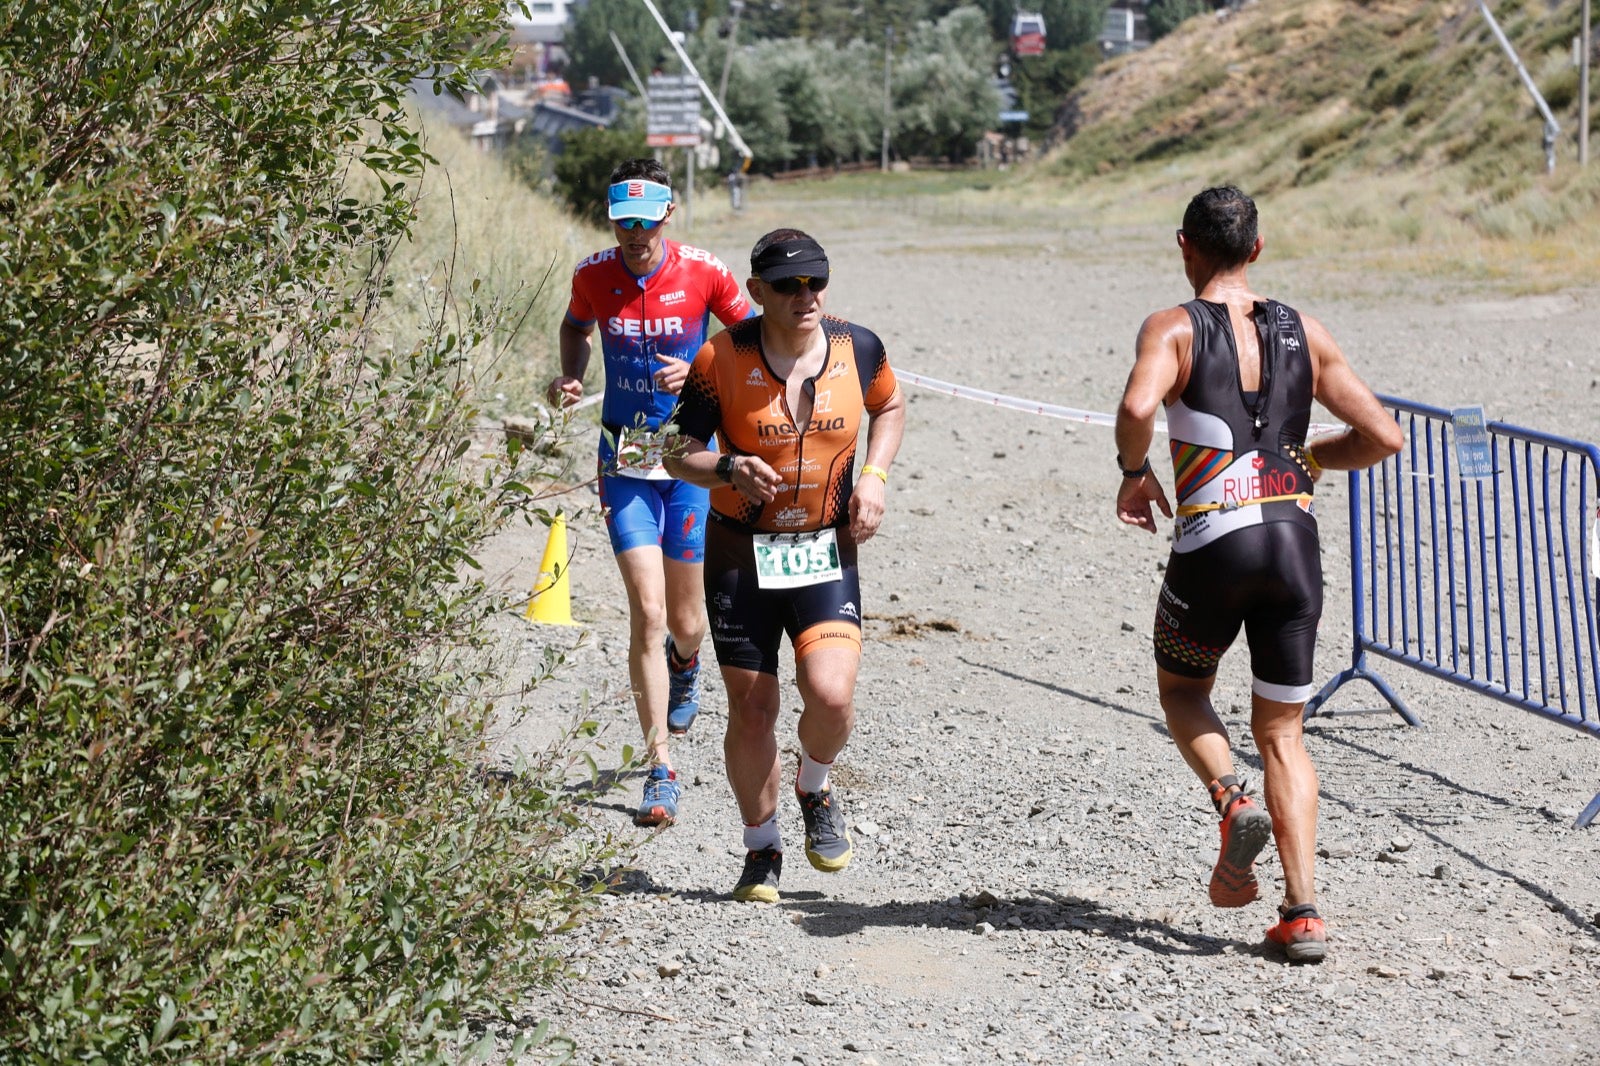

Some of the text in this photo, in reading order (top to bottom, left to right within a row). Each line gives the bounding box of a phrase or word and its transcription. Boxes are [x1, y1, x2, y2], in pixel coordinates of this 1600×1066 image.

[678, 245, 728, 277] SEUR
[659, 289, 686, 303] SEUR
[608, 316, 684, 337] SEUR
[617, 375, 634, 391] J.A.
[1223, 468, 1297, 502] RUBIÑO
[766, 545, 830, 574] 105
[1162, 582, 1190, 610] limpo
